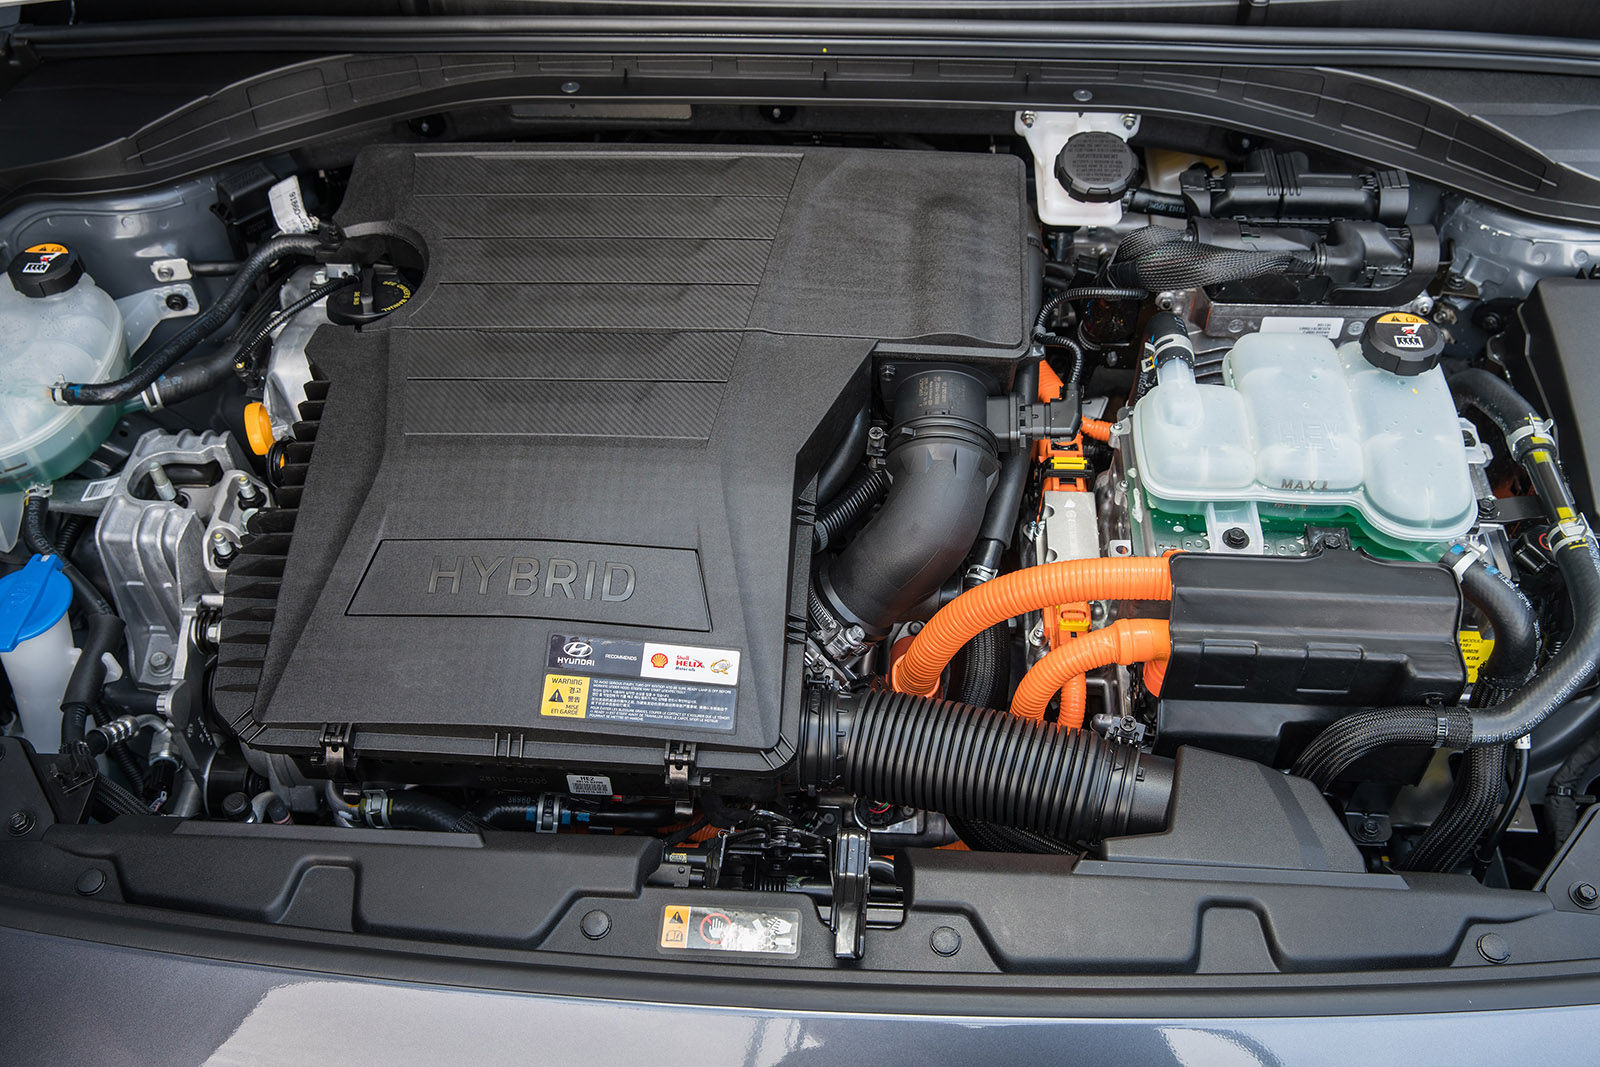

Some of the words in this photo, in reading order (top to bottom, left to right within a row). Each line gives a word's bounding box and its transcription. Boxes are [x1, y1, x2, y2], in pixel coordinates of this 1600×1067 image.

[1281, 478, 1316, 490] MAX
[427, 555, 636, 602] HYBRID
[557, 656, 596, 667] HYUNDAI
[604, 654, 638, 662] RECOMMENDS
[676, 660, 704, 668] HELIX
[552, 678, 583, 686] WARNING
[569, 686, 582, 694] 경고
